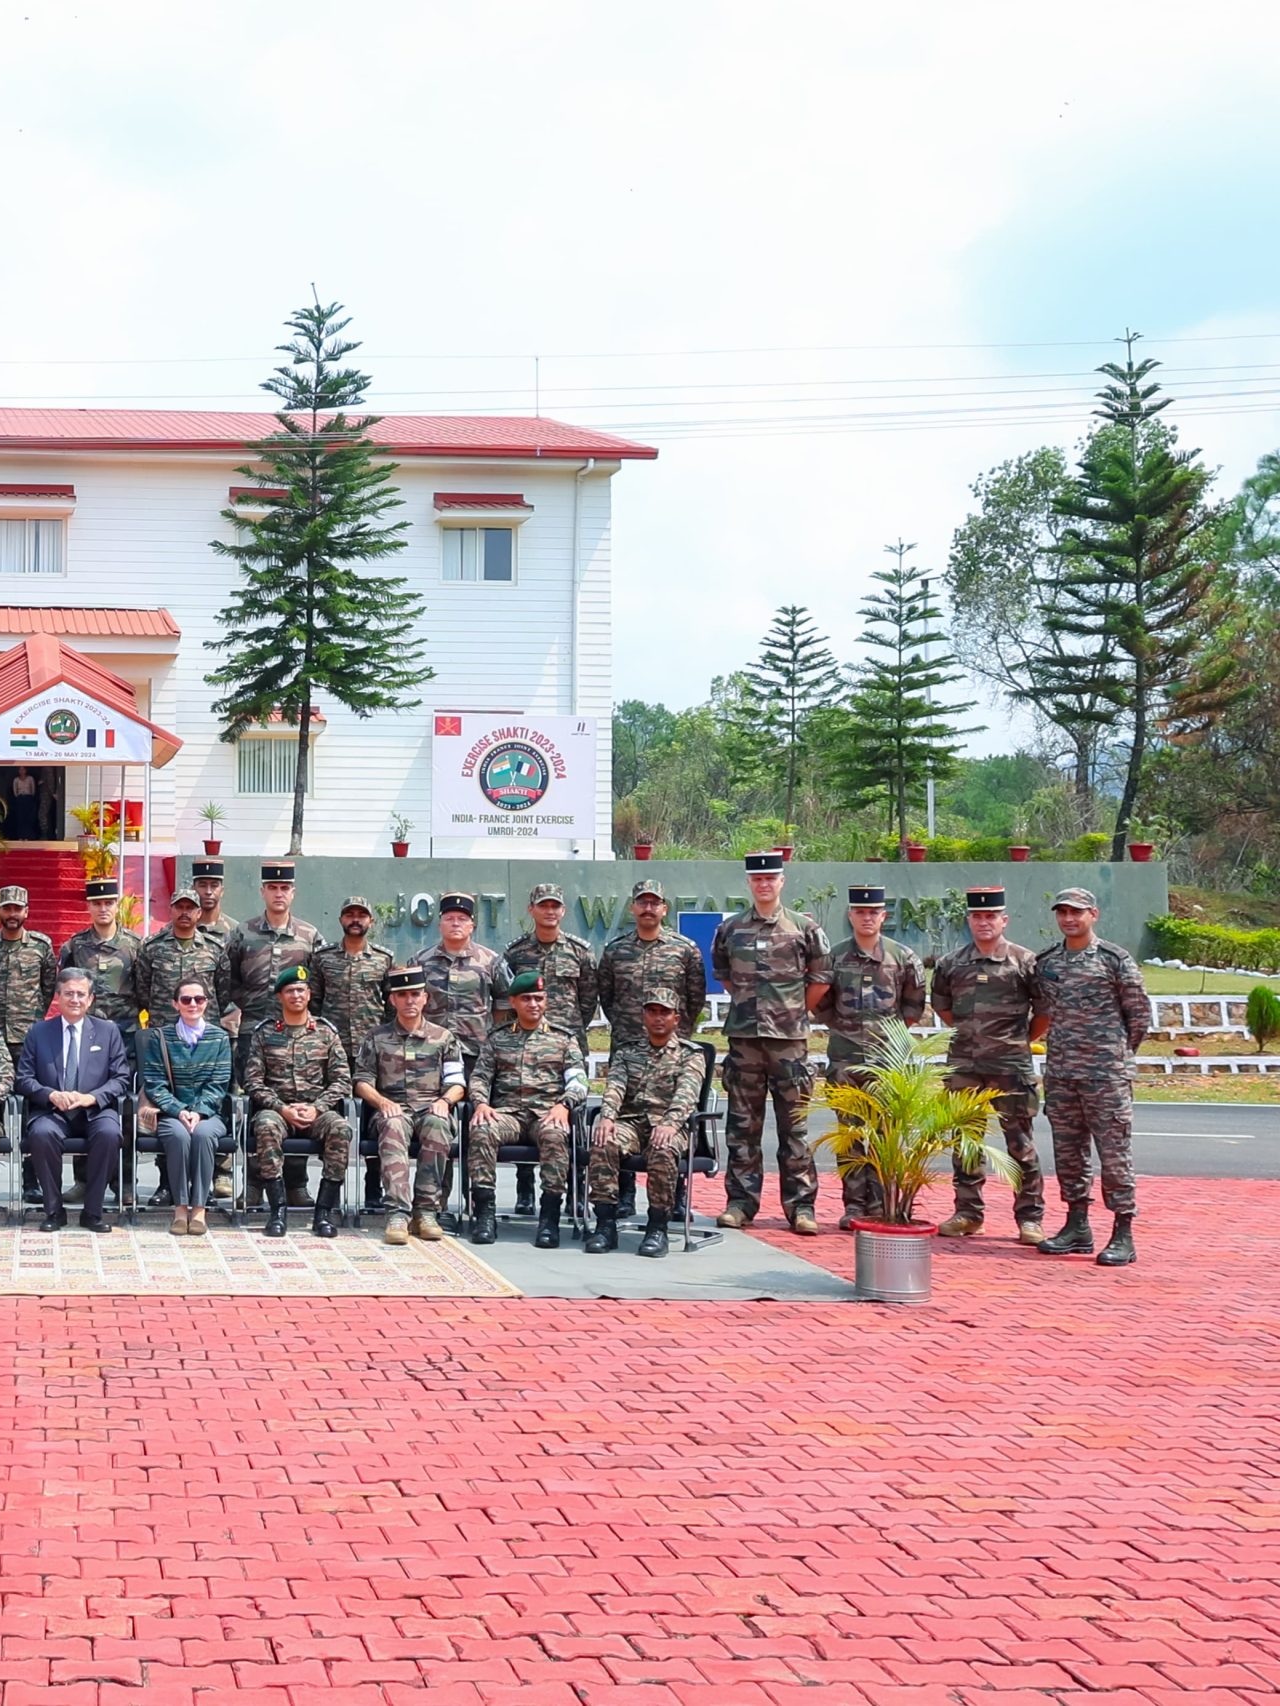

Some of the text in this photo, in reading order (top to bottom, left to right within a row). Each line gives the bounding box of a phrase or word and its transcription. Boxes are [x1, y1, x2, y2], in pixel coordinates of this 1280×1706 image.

[14, 698, 52, 725] EXERCISE
[53, 697, 84, 707] SHAKTI
[461, 726, 567, 780] EXERCISE SHAKTI 2023-2024
[499, 788, 528, 796] SHAKTI
[478, 814, 510, 825] FRANCE
[511, 815, 534, 825] JOINT
[535, 815, 575, 825] EXERCISE
[487, 827, 538, 837] UMROI-2024
